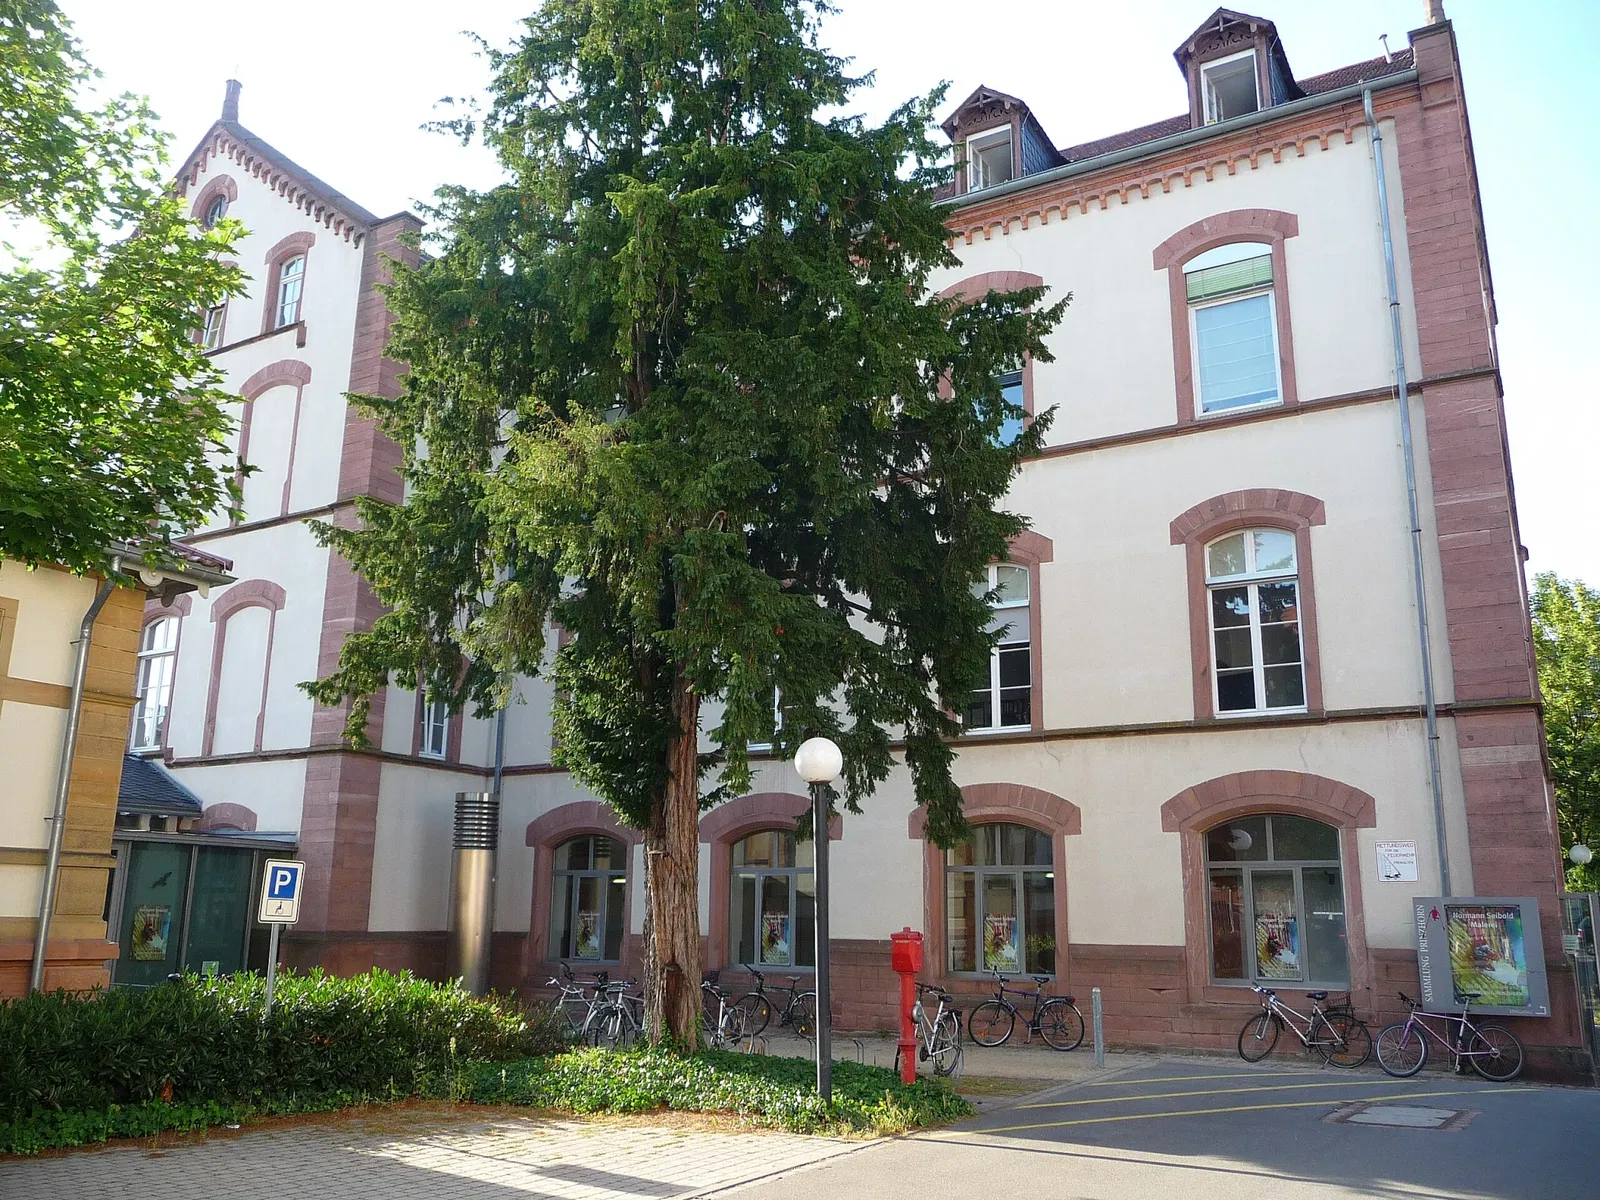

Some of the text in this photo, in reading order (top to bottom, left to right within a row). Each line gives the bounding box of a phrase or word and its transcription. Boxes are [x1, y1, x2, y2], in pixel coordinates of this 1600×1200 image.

[274, 870, 291, 895] P
[1416, 904, 1433, 1003] SAMMLUNG PRINZHORN
